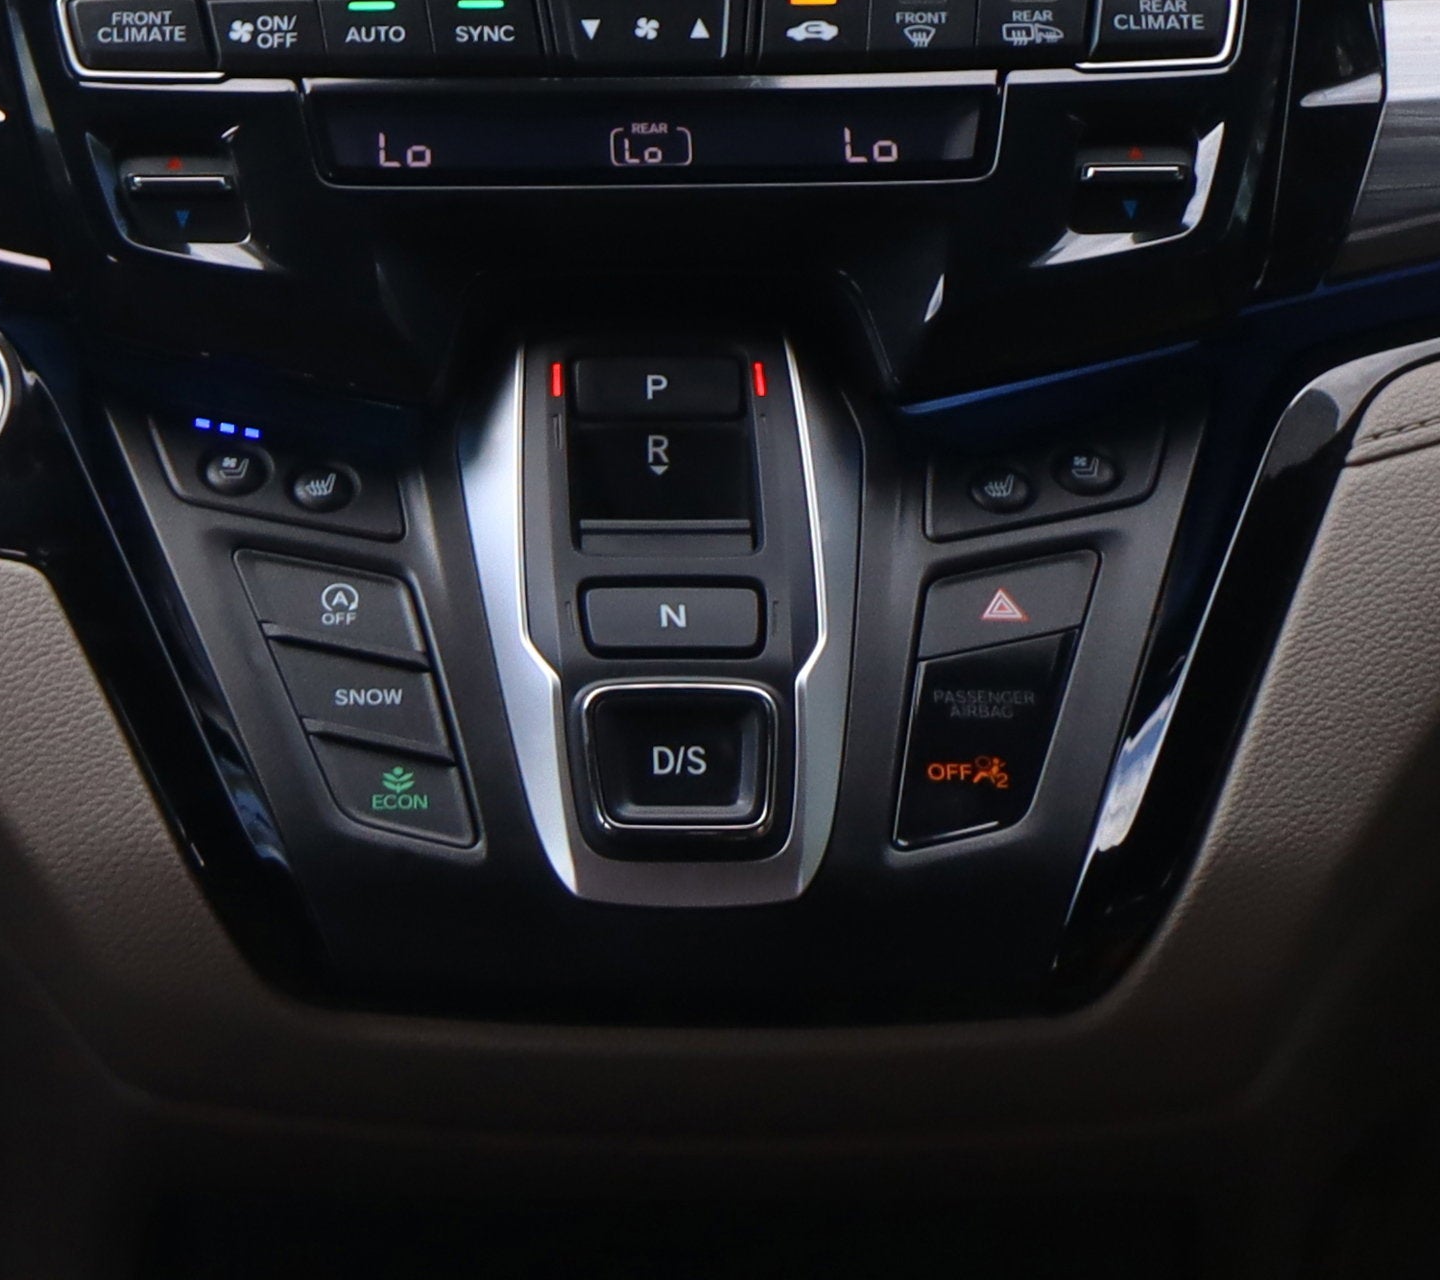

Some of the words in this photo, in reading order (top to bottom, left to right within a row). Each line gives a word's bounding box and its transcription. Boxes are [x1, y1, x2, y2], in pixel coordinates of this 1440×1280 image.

[111, 10, 172, 26] FRONT
[256, 14, 297, 32] ON/
[895, 10, 949, 25] FRONT
[1011, 9, 1054, 23] REAR
[1113, 12, 1205, 32] CLIMATE
[97, 25, 187, 44] CLIMATE
[256, 31, 298, 49] OFF
[345, 25, 407, 43] AUTO
[455, 24, 516, 43] SYNC
[630, 122, 669, 135] REAR
[377, 131, 432, 169] Lo
[623, 138, 663, 164] Lo
[844, 126, 899, 163] Lo
[645, 375, 669, 400] P
[646, 435, 670, 464] R
[321, 611, 357, 626] OFF
[660, 603, 687, 628] N
[334, 687, 404, 706] SNOW
[933, 689, 1036, 707] PASSENGER
[949, 704, 1014, 720] AIRBAG
[652, 745, 708, 775] D/S
[927, 762, 973, 782] OFF
[371, 793, 430, 811] ECON
